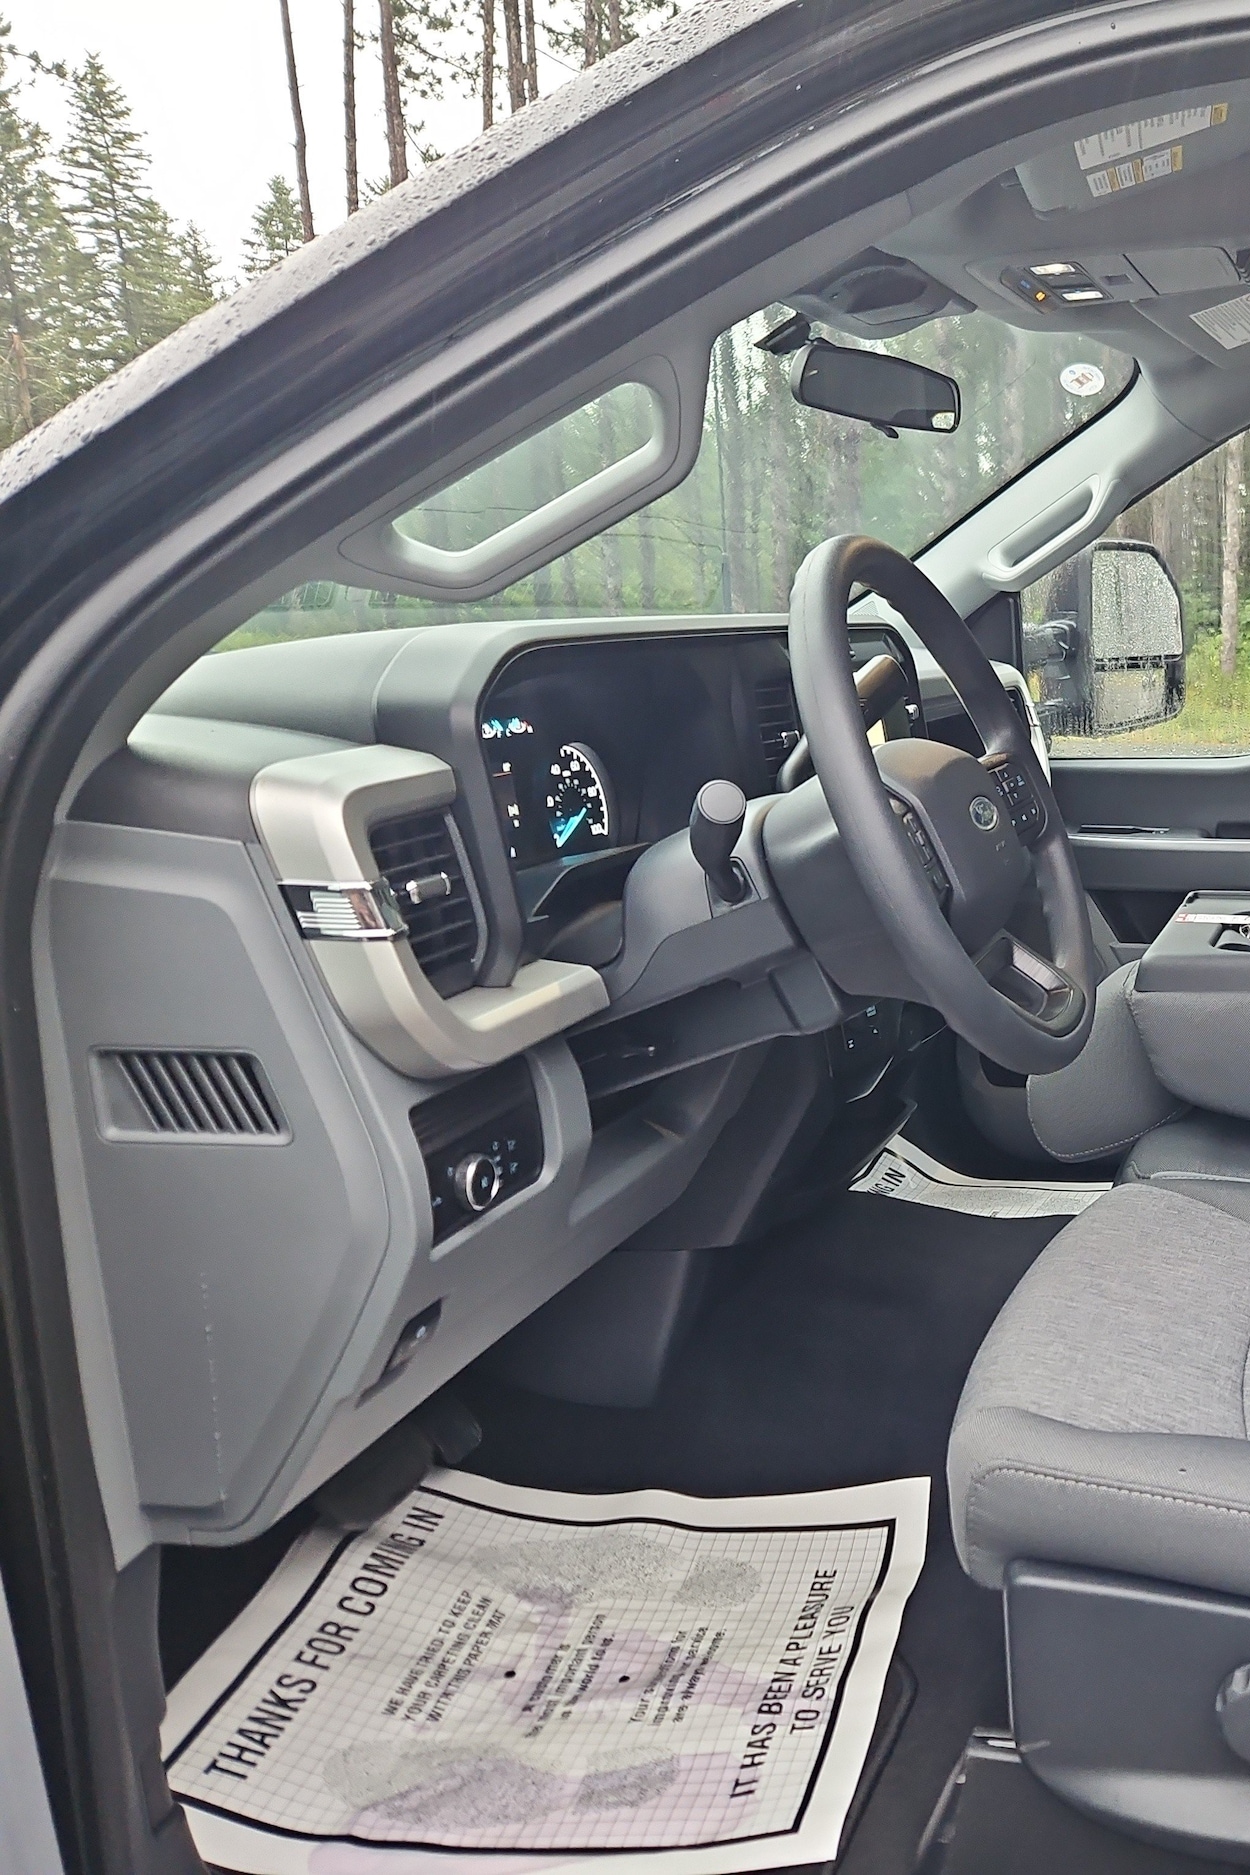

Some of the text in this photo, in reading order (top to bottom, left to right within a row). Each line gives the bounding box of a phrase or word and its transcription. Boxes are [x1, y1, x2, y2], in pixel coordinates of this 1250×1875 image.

[881, 1167, 906, 1187] IN
[203, 1506, 445, 1780] THANKS FOR COMING IN
[381, 1590, 472, 1716] WE HAVE TRIED TO KEEP
[402, 1596, 493, 1722] YOUR CARPETING CLEAN
[426, 1608, 506, 1722] WITH THIS PAPER MAT
[729, 1568, 838, 1799] IT HAS BEEN A PLEASURE
[790, 1605, 855, 1735] TO SERVE YOU
